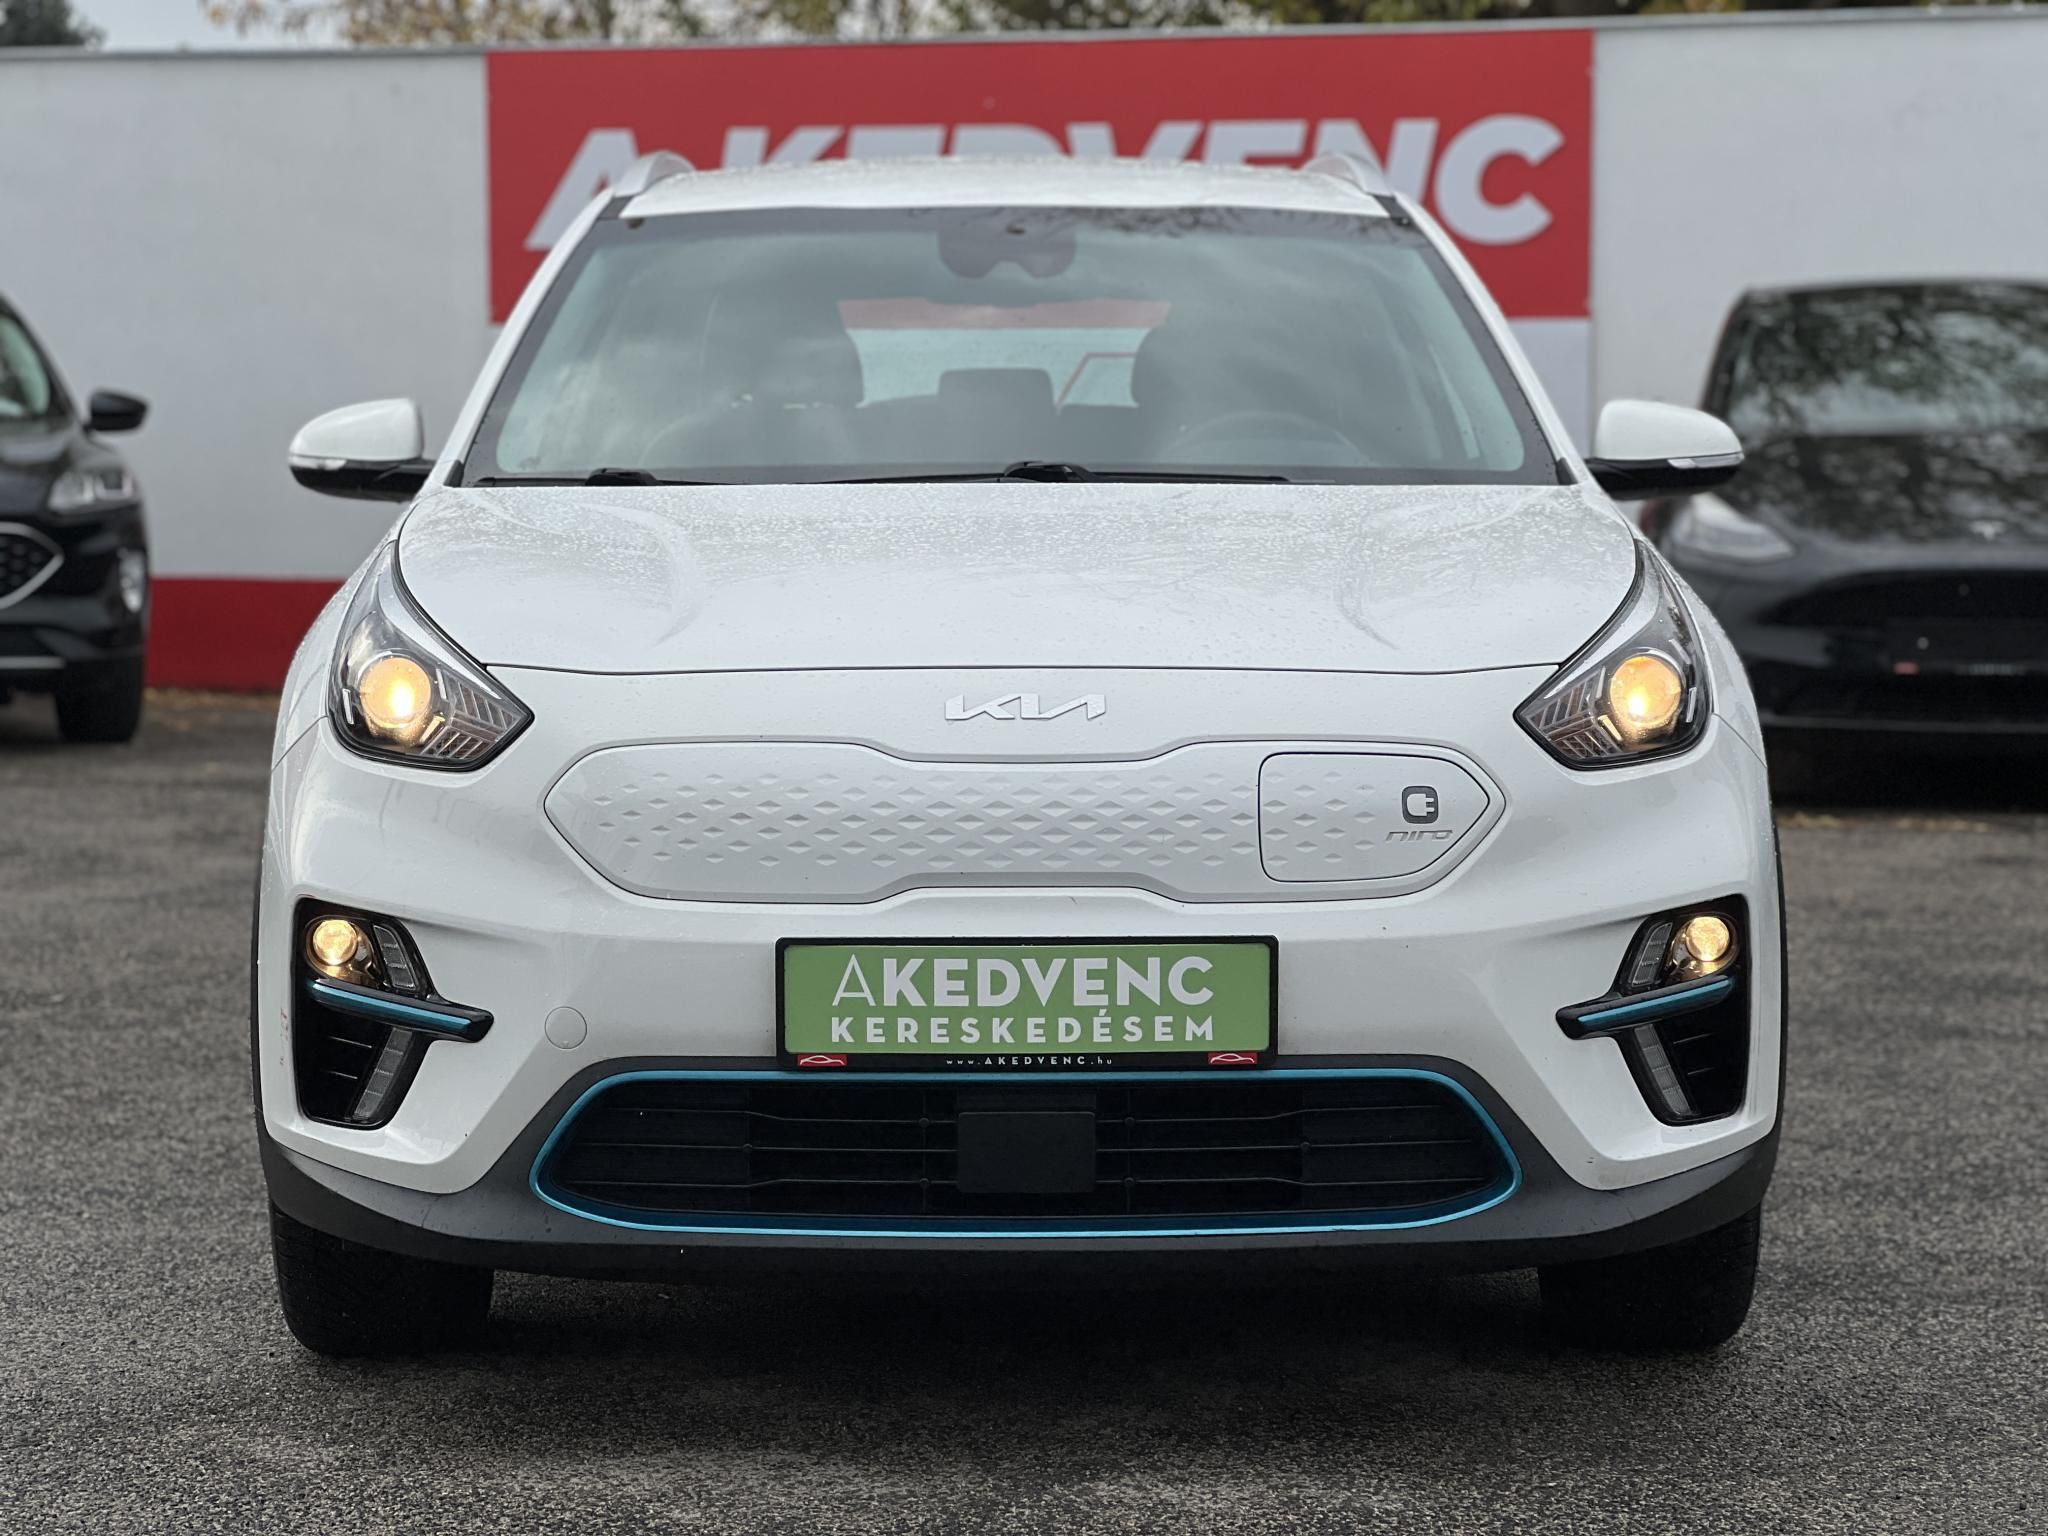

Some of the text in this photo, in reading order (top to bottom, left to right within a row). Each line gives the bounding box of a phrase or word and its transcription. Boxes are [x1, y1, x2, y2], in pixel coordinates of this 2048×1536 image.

[945, 694, 1106, 720] KIA
[831, 955, 1214, 1006] AKEDVENC
[831, 1009, 1214, 1043] KERESKEDÉSEM
